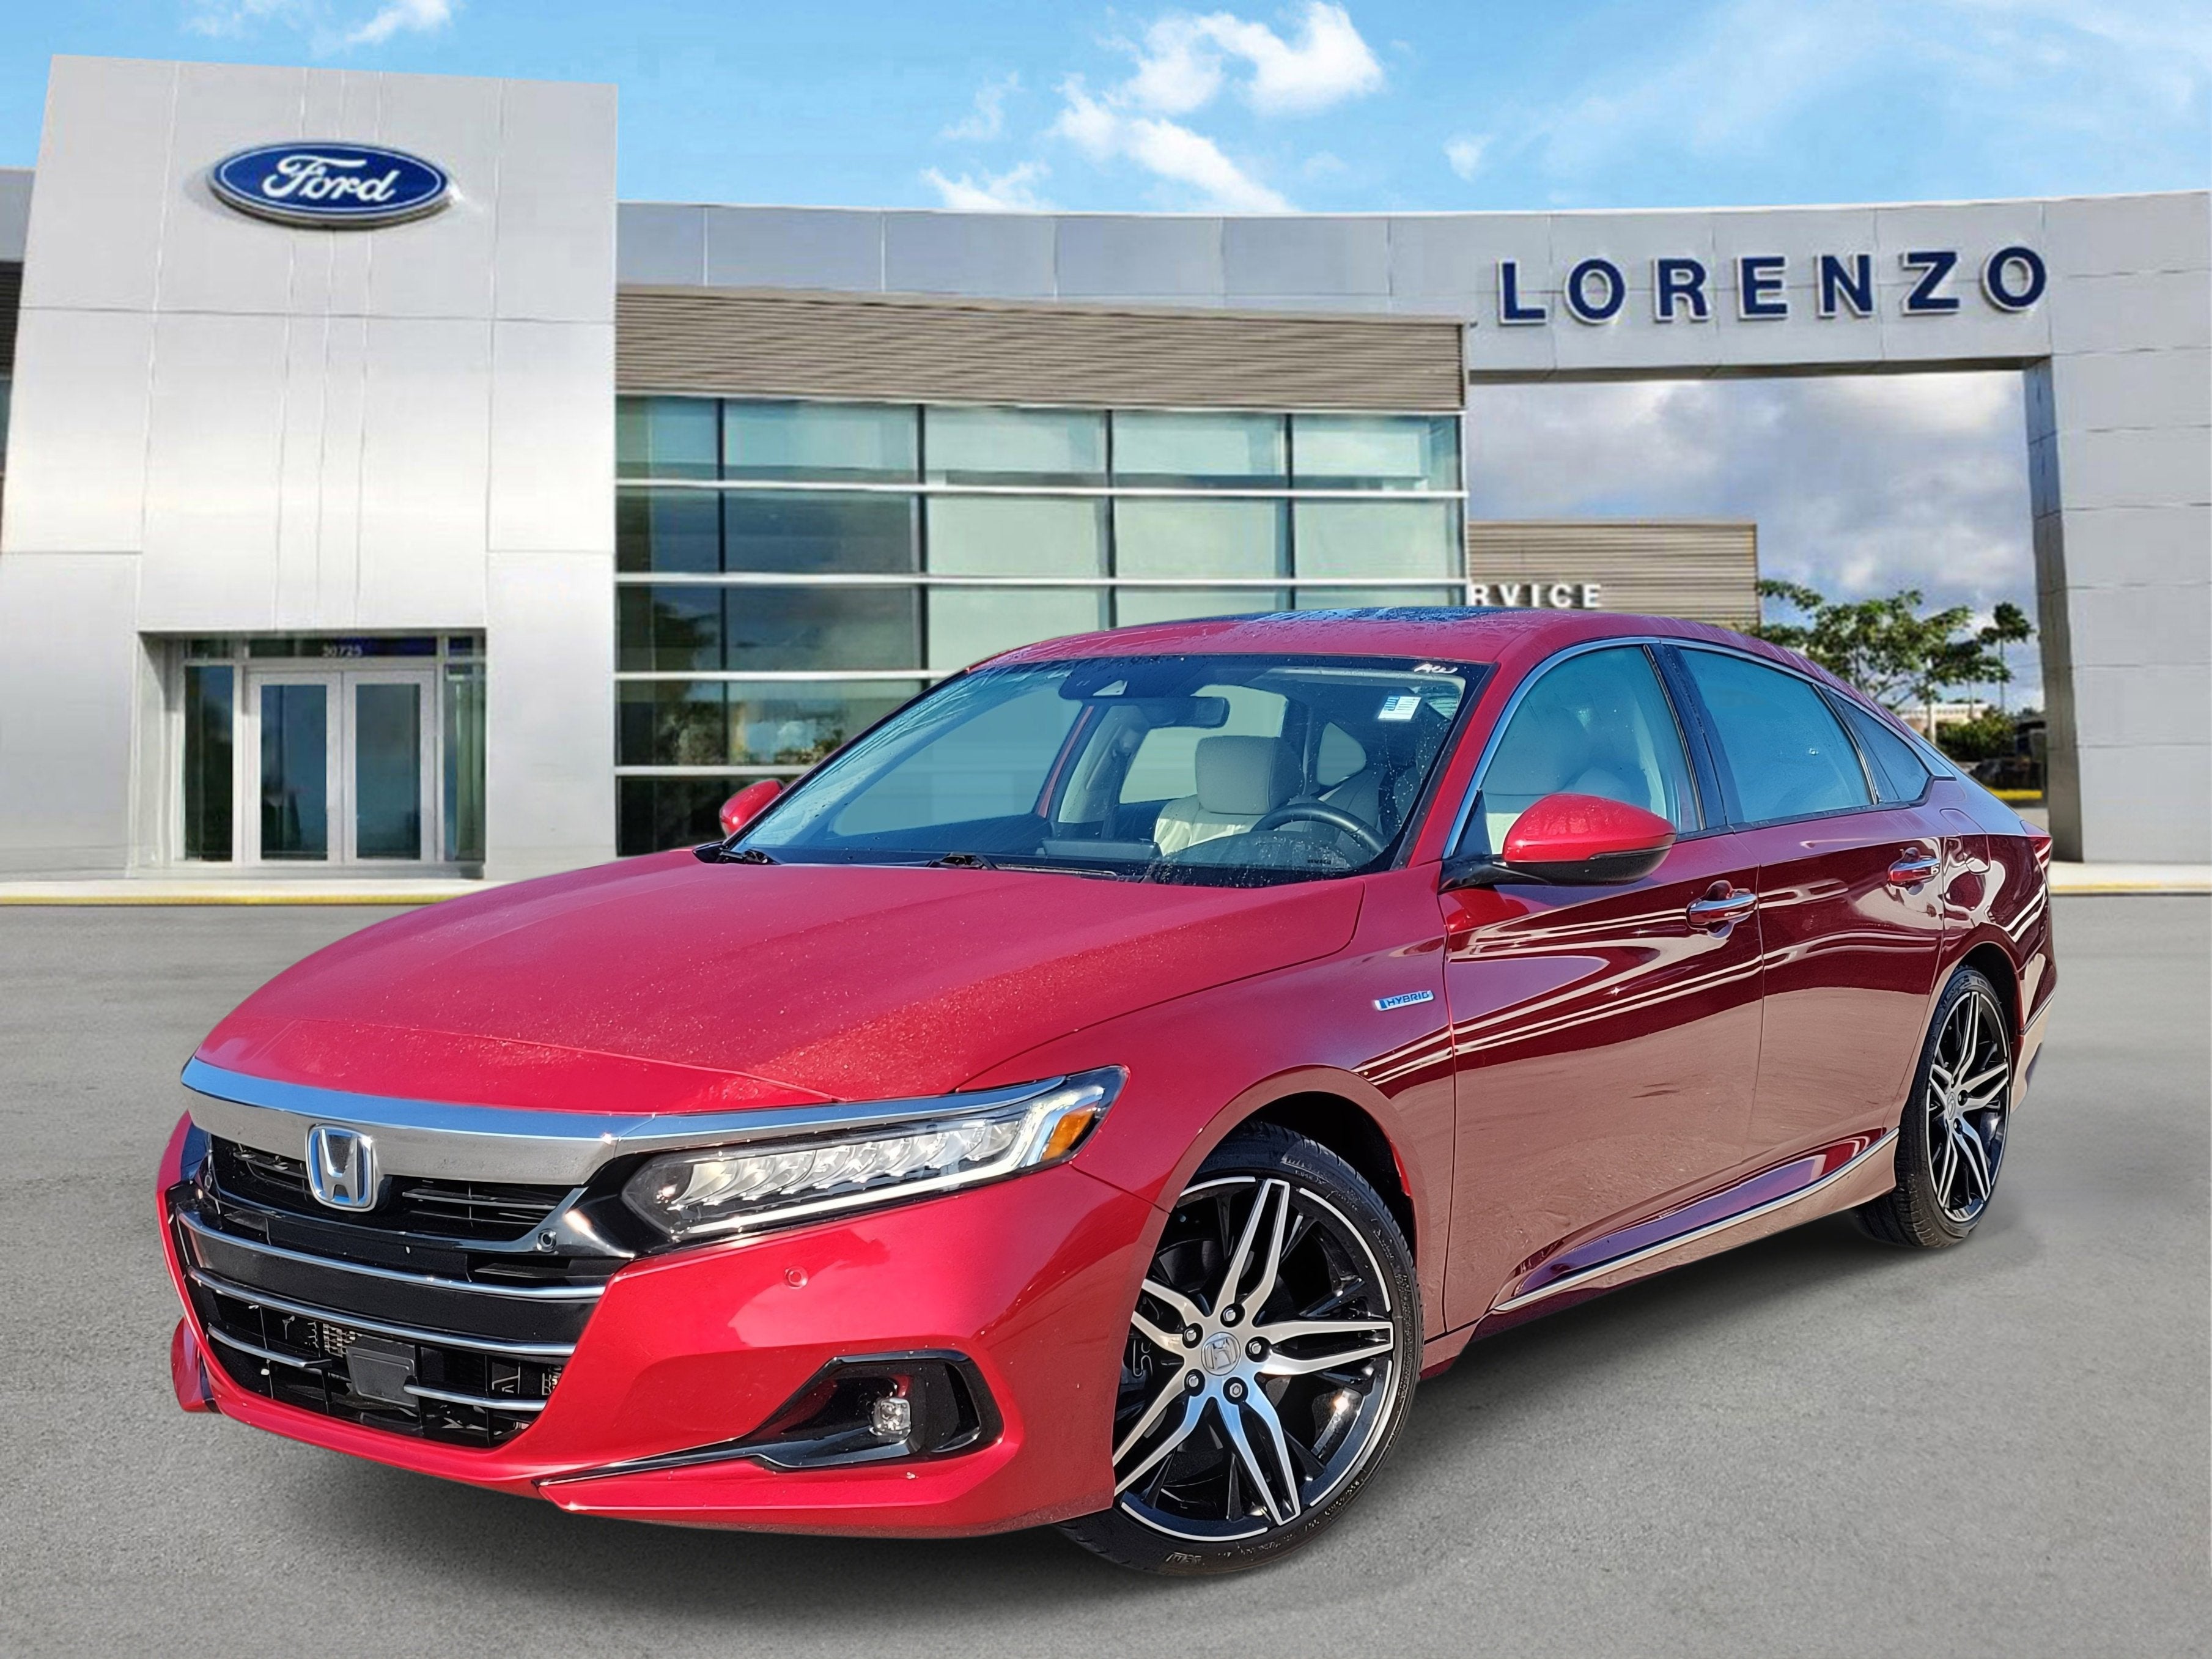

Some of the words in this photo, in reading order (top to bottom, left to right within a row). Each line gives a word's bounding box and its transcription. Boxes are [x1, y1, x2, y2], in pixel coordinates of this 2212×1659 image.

[263, 155, 400, 201] Ford
[1498, 246, 2047, 325] LORENZO
[1469, 583, 1602, 608] RVICE
[1387, 991, 1429, 1007] HYBRID
